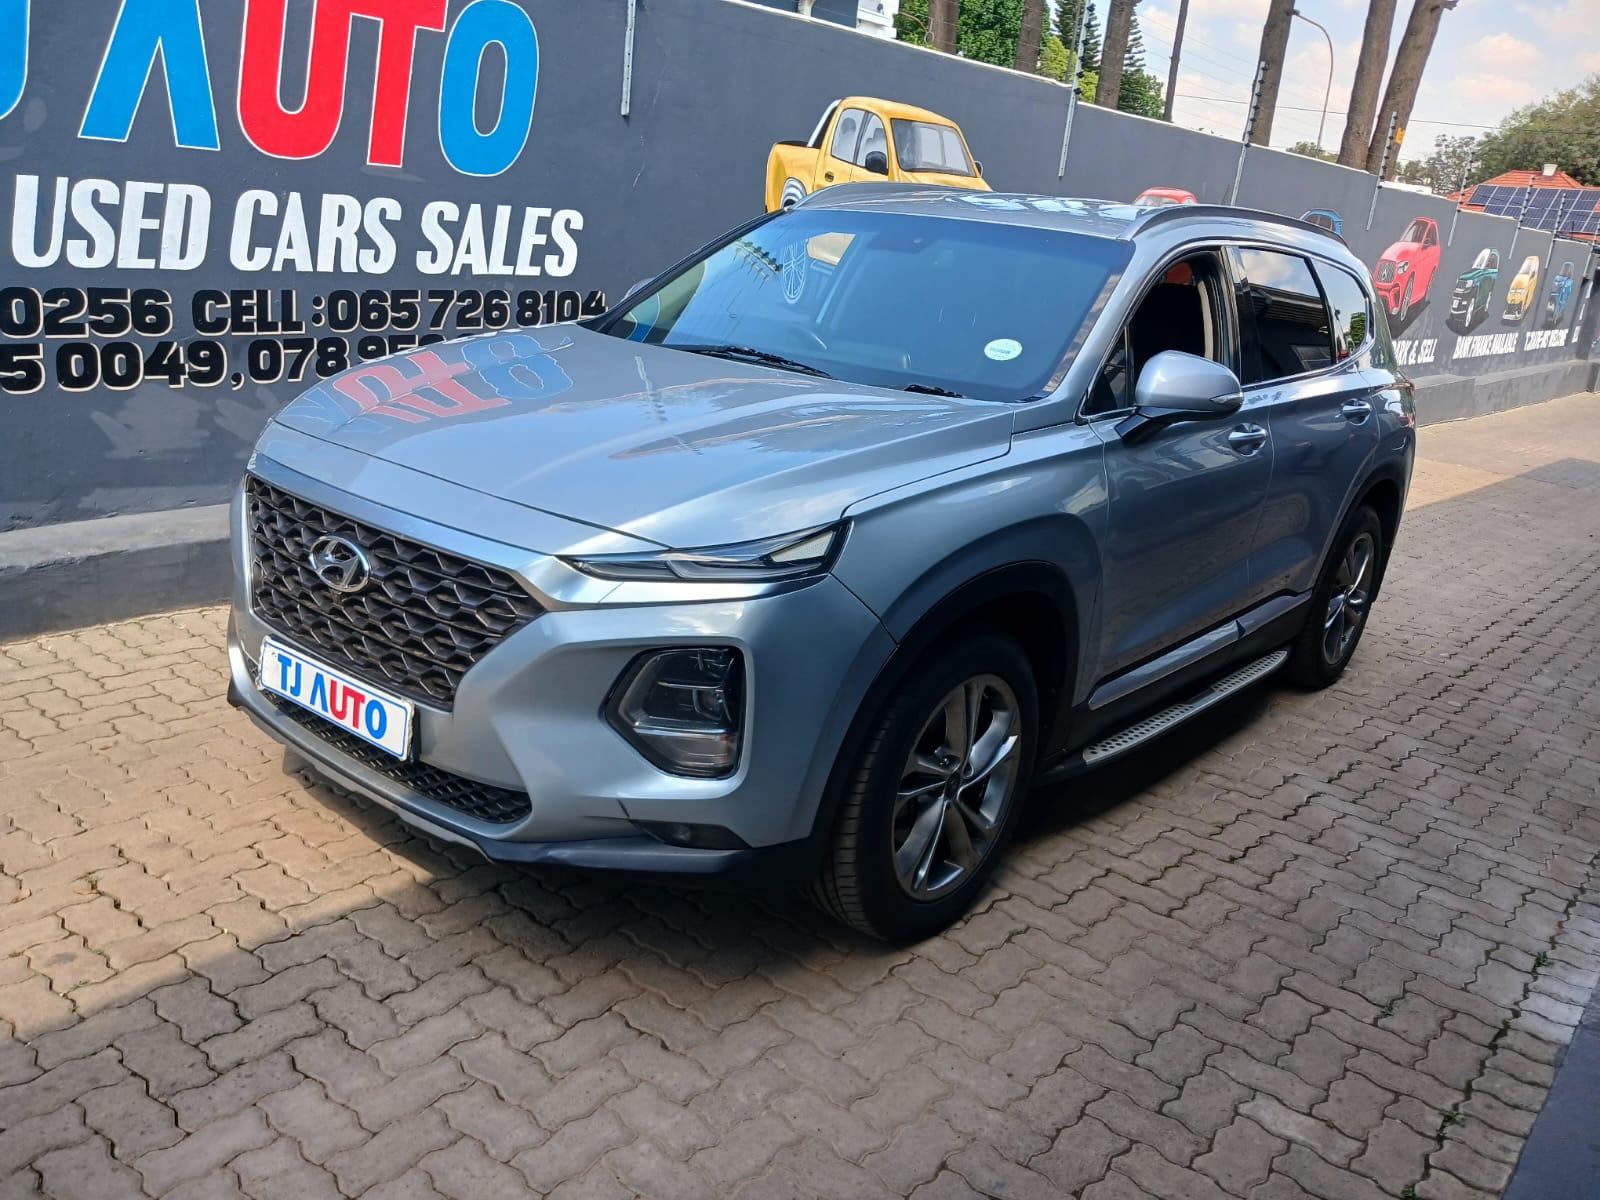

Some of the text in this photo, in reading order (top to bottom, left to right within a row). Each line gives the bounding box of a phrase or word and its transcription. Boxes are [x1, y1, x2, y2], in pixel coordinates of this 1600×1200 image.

[77, 0, 538, 177] AUTO
[12, 174, 584, 277] USED CARS SALES
[428, 290, 510, 330] 726
[516, 290, 609, 328] 8104
[1417, 338, 1438, 364] SELL
[277, 653, 388, 740] TJ AUTO
